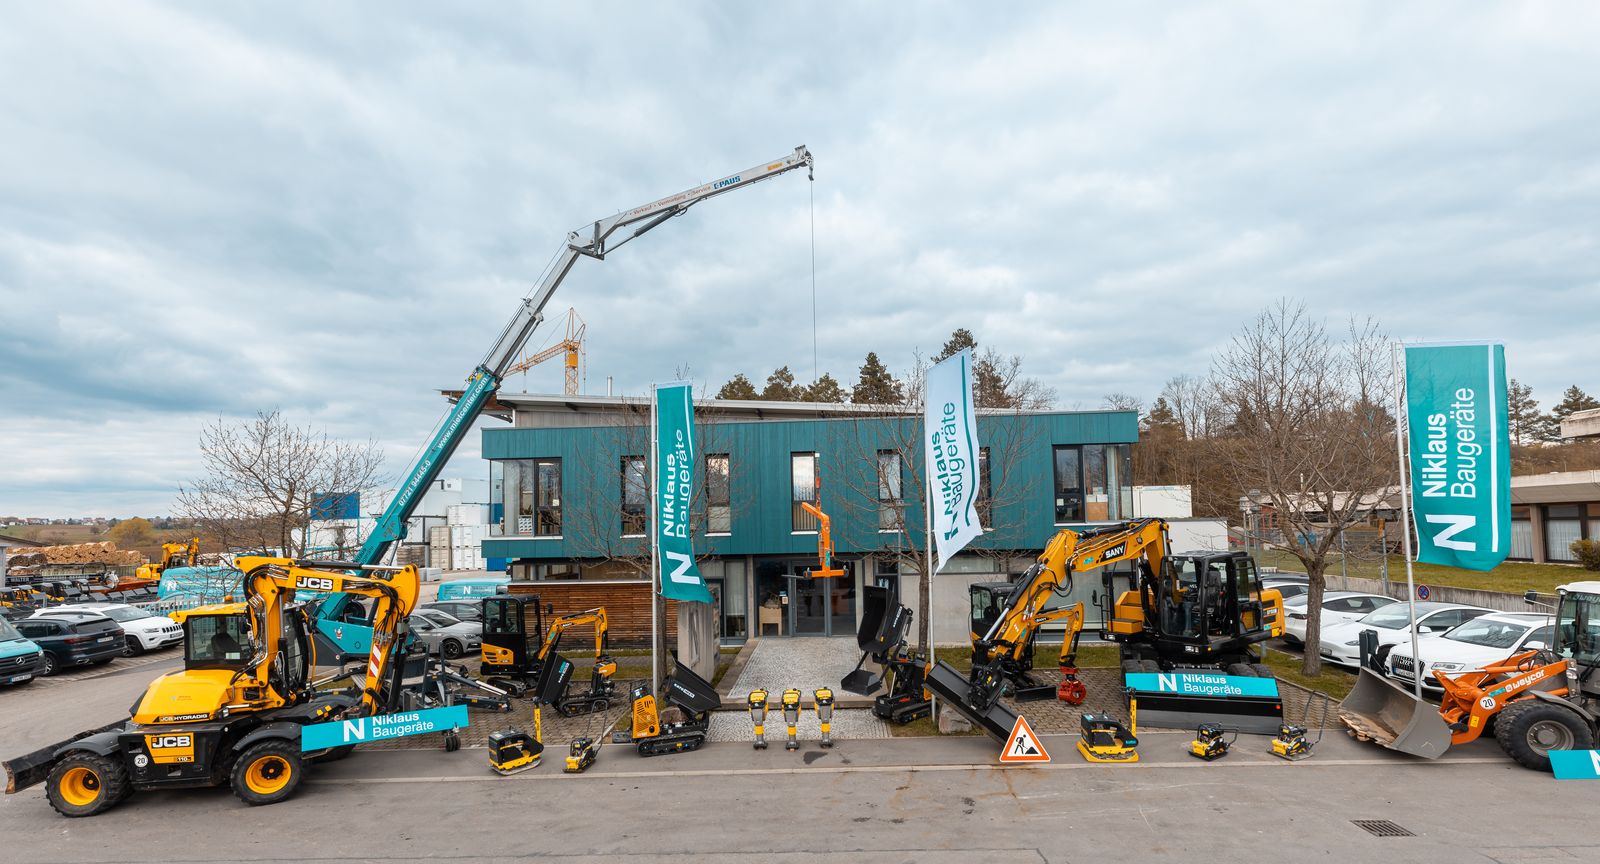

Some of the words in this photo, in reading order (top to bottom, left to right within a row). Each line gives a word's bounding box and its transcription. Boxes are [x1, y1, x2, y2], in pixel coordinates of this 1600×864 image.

[1450, 388, 1482, 499] Baugeräte
[941, 402, 965, 509] Baugeräte
[1421, 413, 1447, 498] Niklaus
[931, 431, 953, 516] Niklaus
[663, 453, 676, 537] Niklaus
[1425, 514, 1476, 552] N
[1105, 545, 1124, 559] SANY
[665, 550, 701, 585] N
[296, 577, 333, 590] JCB
[1158, 673, 1178, 692] N
[1182, 673, 1227, 684] Niklaus
[1183, 682, 1242, 695] Baugeräte
[1512, 669, 1545, 690] weycor
[1482, 698, 1494, 708] 20
[372, 713, 419, 726] Niklaus
[372, 721, 434, 738] Baugeräte
[343, 718, 365, 742] N
[152, 736, 191, 748] JCB
